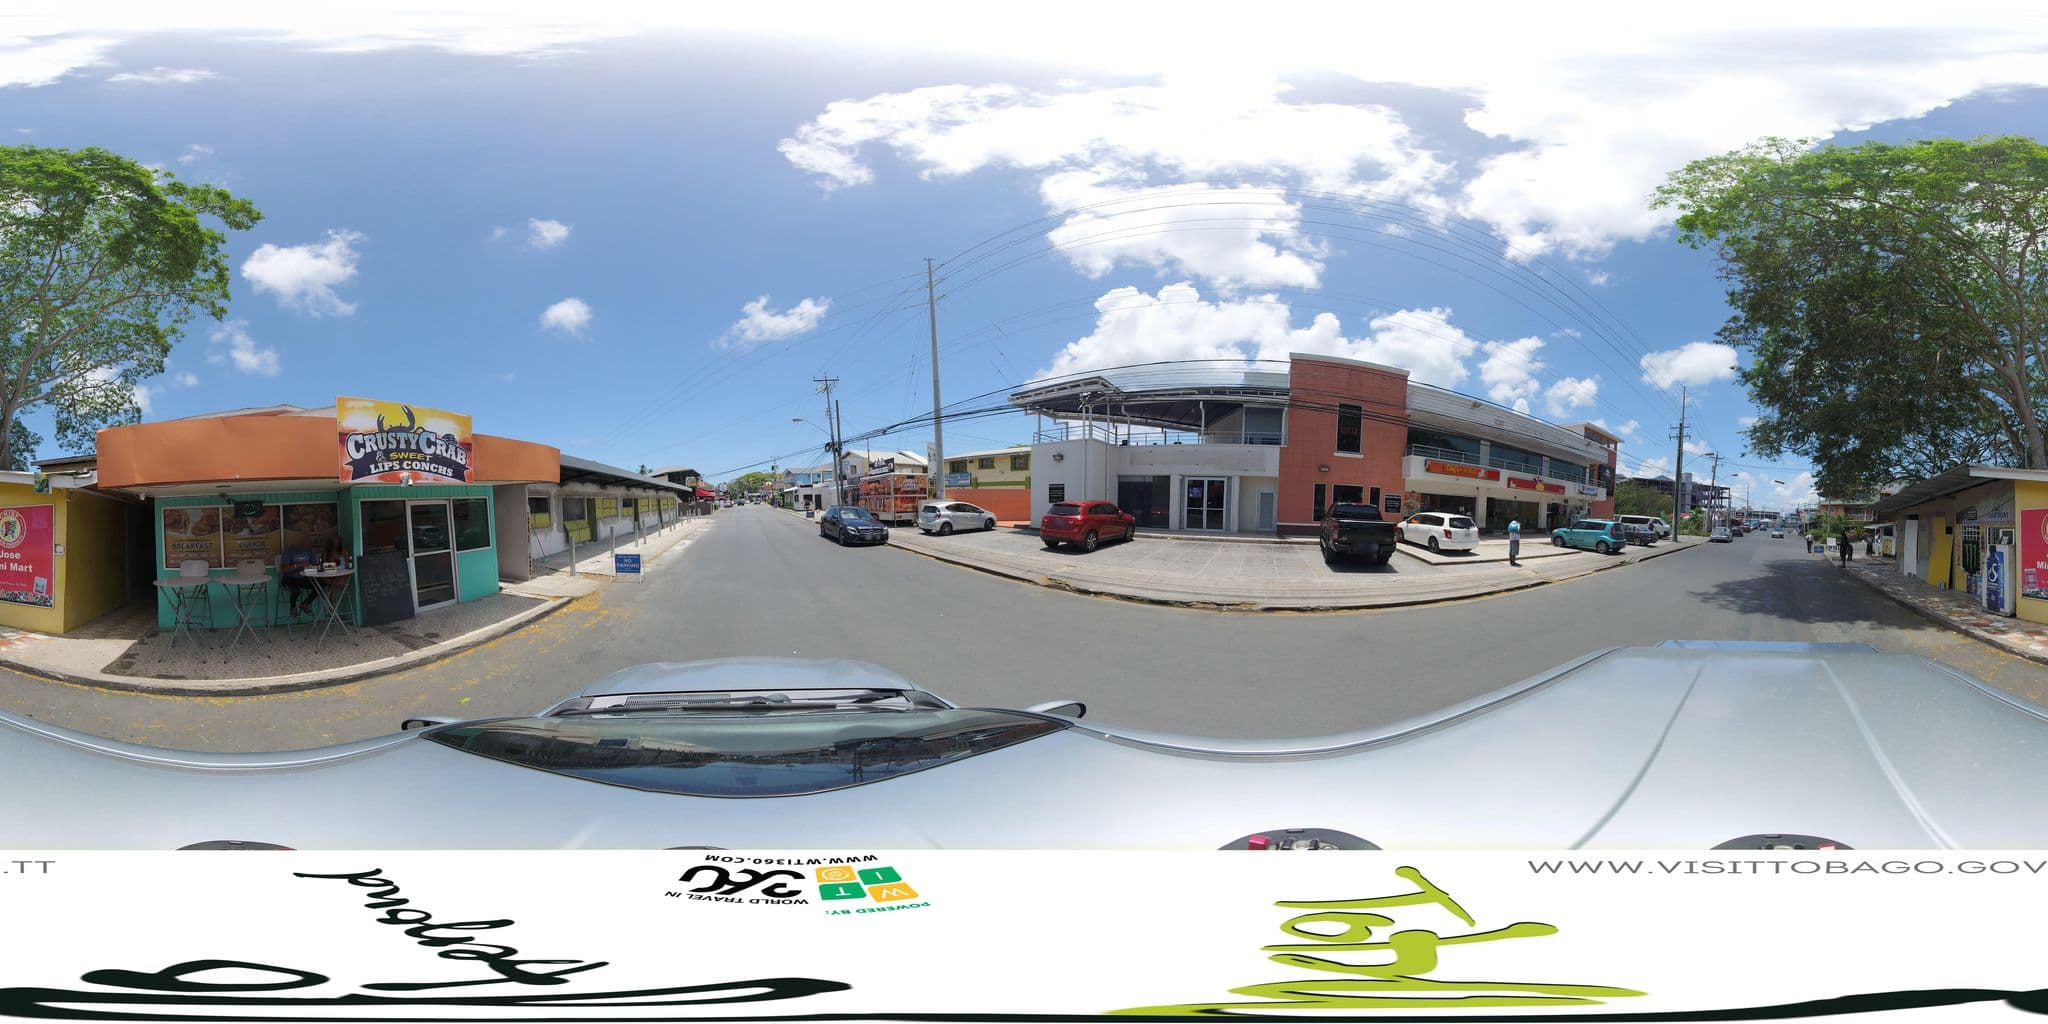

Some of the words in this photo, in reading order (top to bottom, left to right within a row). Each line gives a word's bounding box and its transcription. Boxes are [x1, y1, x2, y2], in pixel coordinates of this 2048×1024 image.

[347, 431, 420, 460] CRUSTY
[418, 430, 467, 466] CRAB
[375, 451, 386, 462] &
[389, 451, 433, 462] SWEET
[369, 461, 400, 474] LIPS
[402, 460, 453, 477] CONCHS
[172, 542, 213, 550] BREAKFAST
[10, 563, 33, 573] Mart
